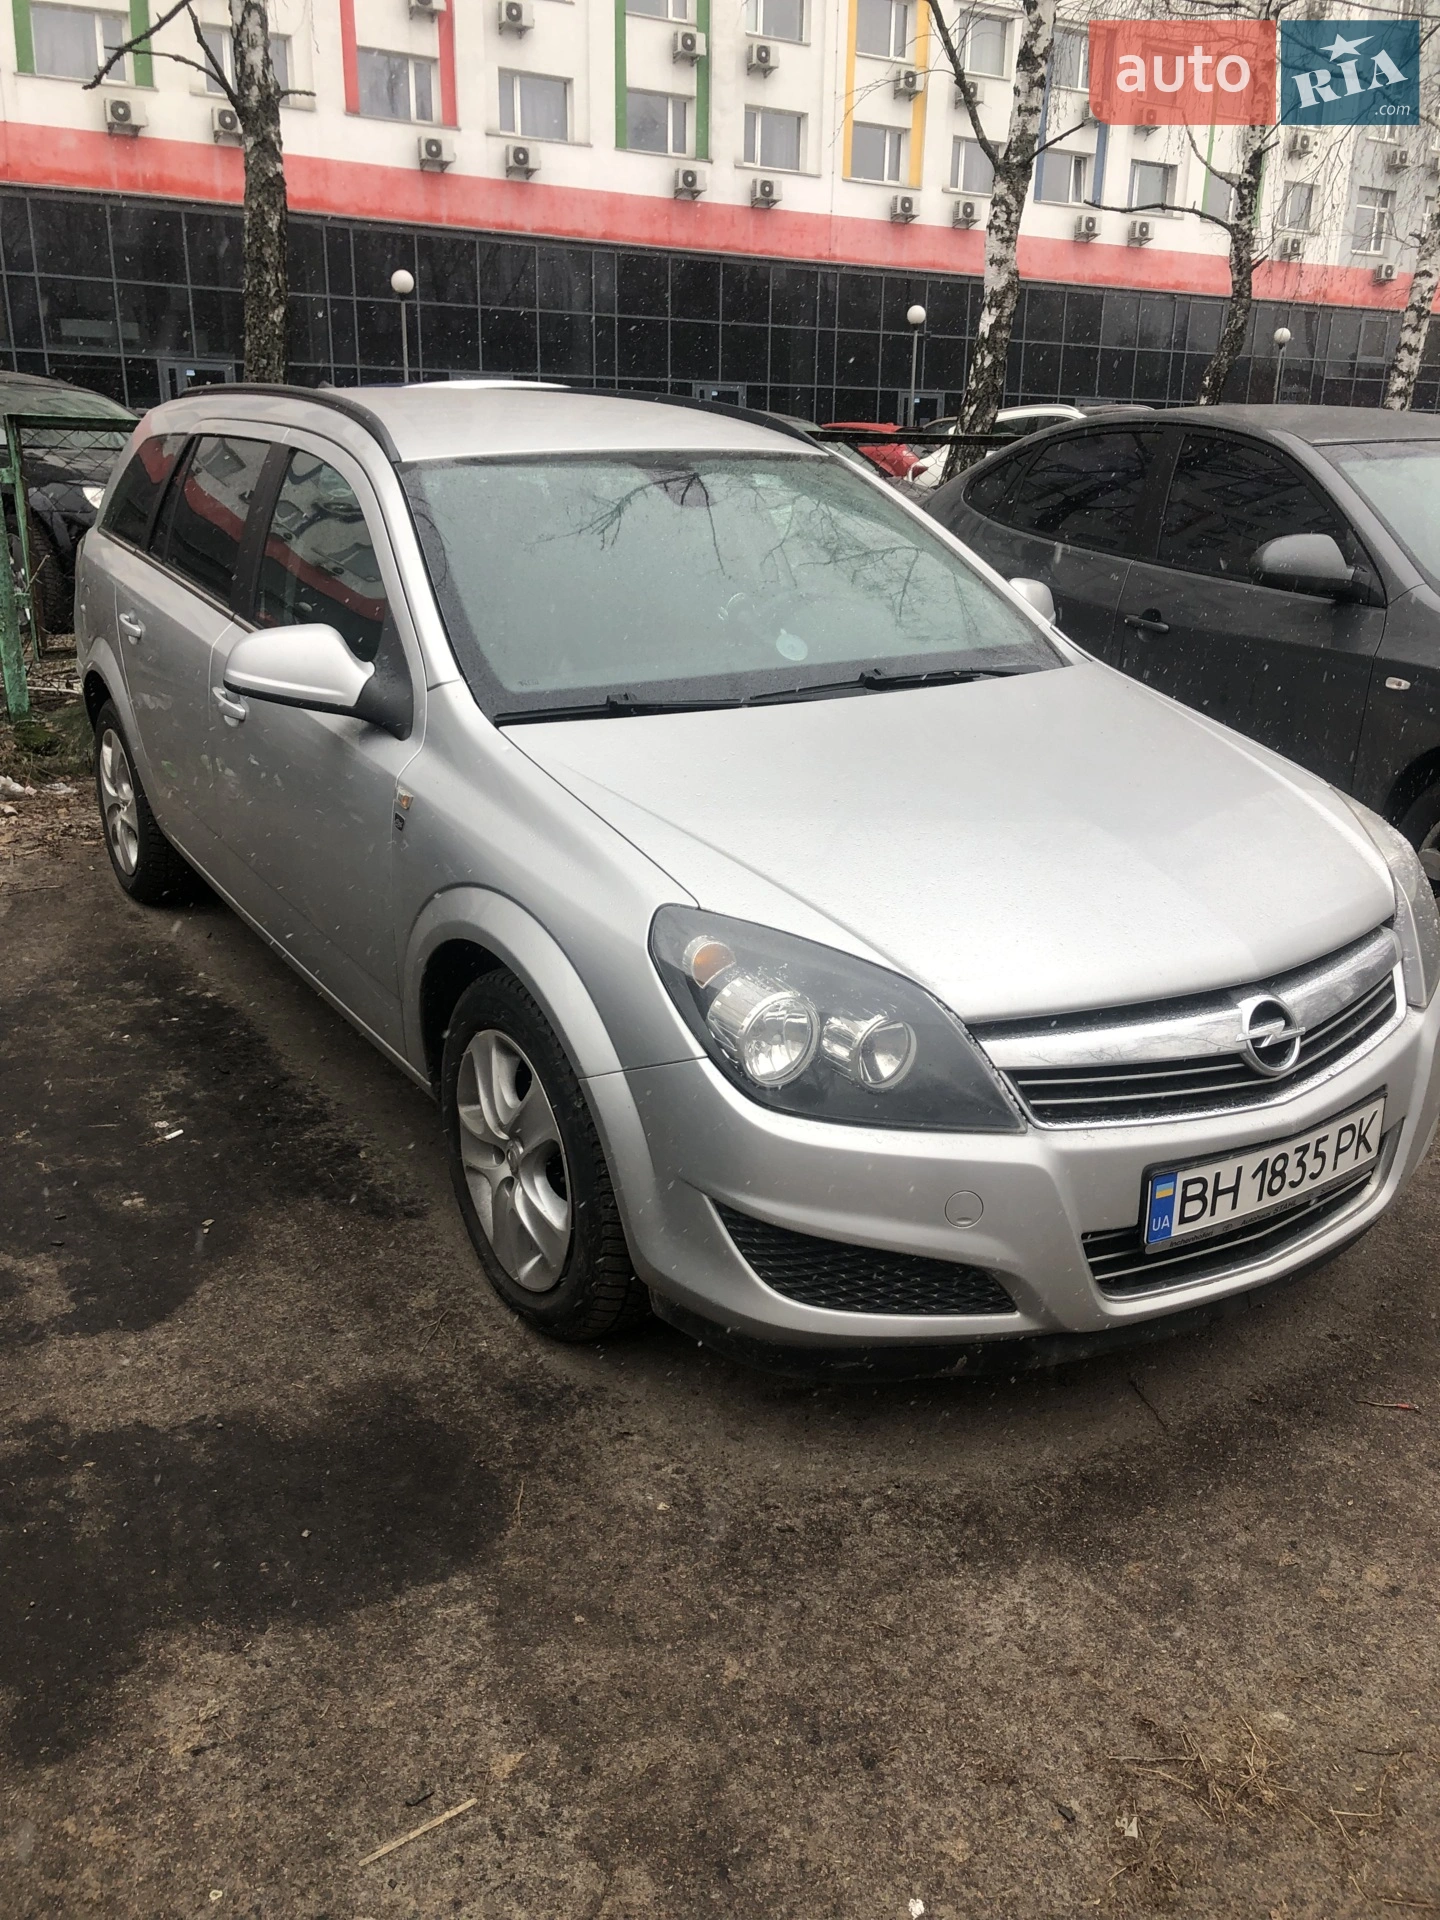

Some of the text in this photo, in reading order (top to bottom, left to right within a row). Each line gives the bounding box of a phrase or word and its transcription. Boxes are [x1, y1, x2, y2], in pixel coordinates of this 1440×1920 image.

[1177, 1110, 1379, 1226] BH 1835 PK
[1152, 1214, 1170, 1231] UA
